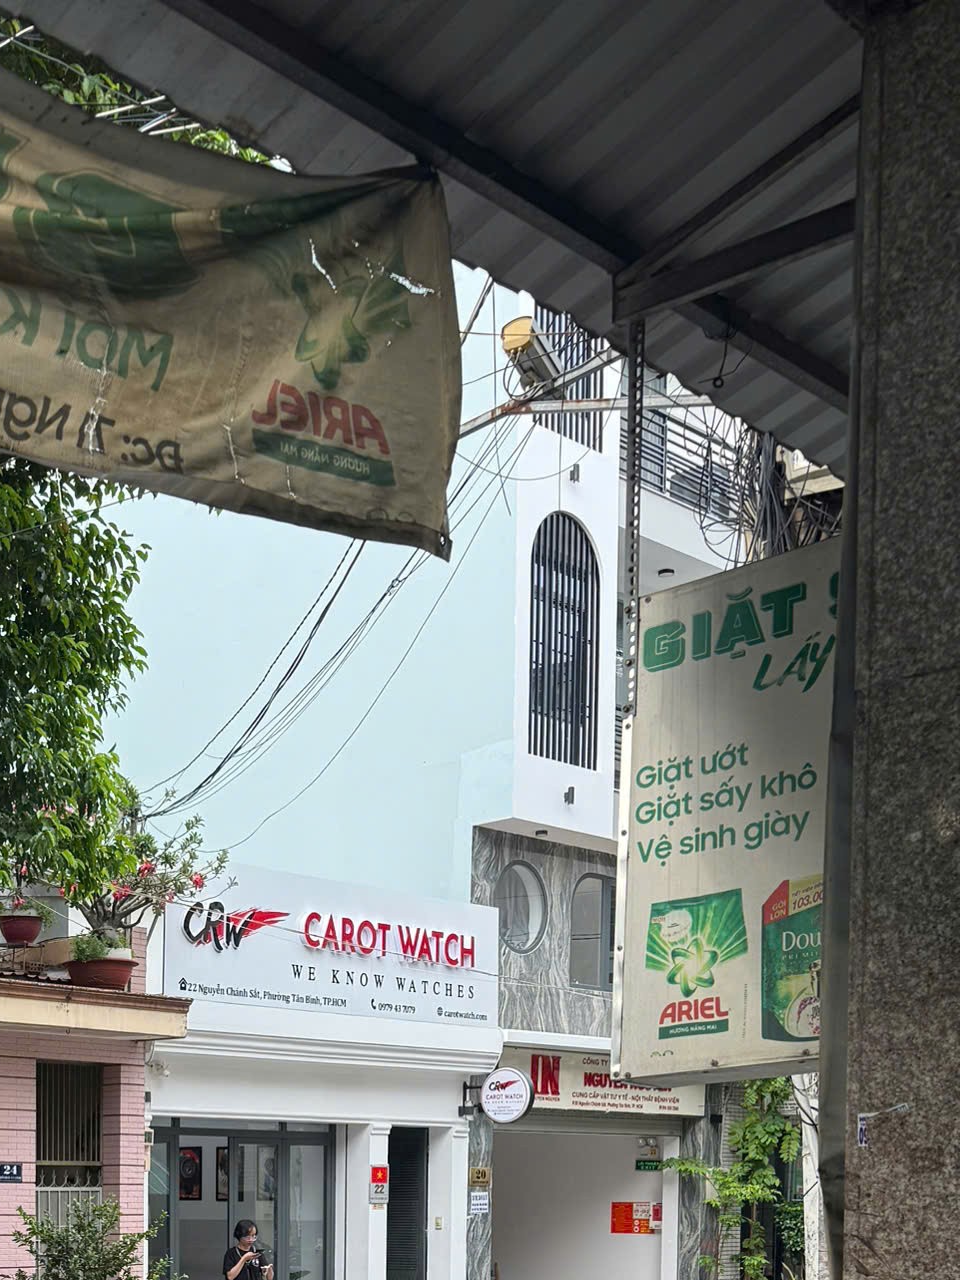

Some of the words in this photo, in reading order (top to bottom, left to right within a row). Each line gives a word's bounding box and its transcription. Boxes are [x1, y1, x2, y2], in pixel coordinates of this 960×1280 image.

[643, 582, 807, 673] GIẶT
[752, 631, 836, 693] LẤY
[636, 756, 693, 790] Giặt
[700, 743, 748, 775] ướt
[635, 792, 692, 826] Giặt
[699, 776, 752, 812] sấy
[760, 762, 817, 799] khô
[637, 834, 672, 866] Vệ
[679, 824, 736, 855] sinh
[744, 810, 810, 850] giày
[303, 911, 390, 957] CAROT
[397, 924, 476, 968] WATCH
[188, 983, 197, 992] 22
[198, 984, 225, 996] Nguyễn
[226, 986, 248, 997] Chánh
[291, 964, 316, 980] WE
[331, 968, 384, 988] KNOW
[396, 976, 475, 999] WATCHES
[658, 996, 728, 1026] ARIEL
[3, 1165, 17, 1175] 24
[374, 1184, 384, 1194] 22
[475, 1169, 486, 1179] 20
